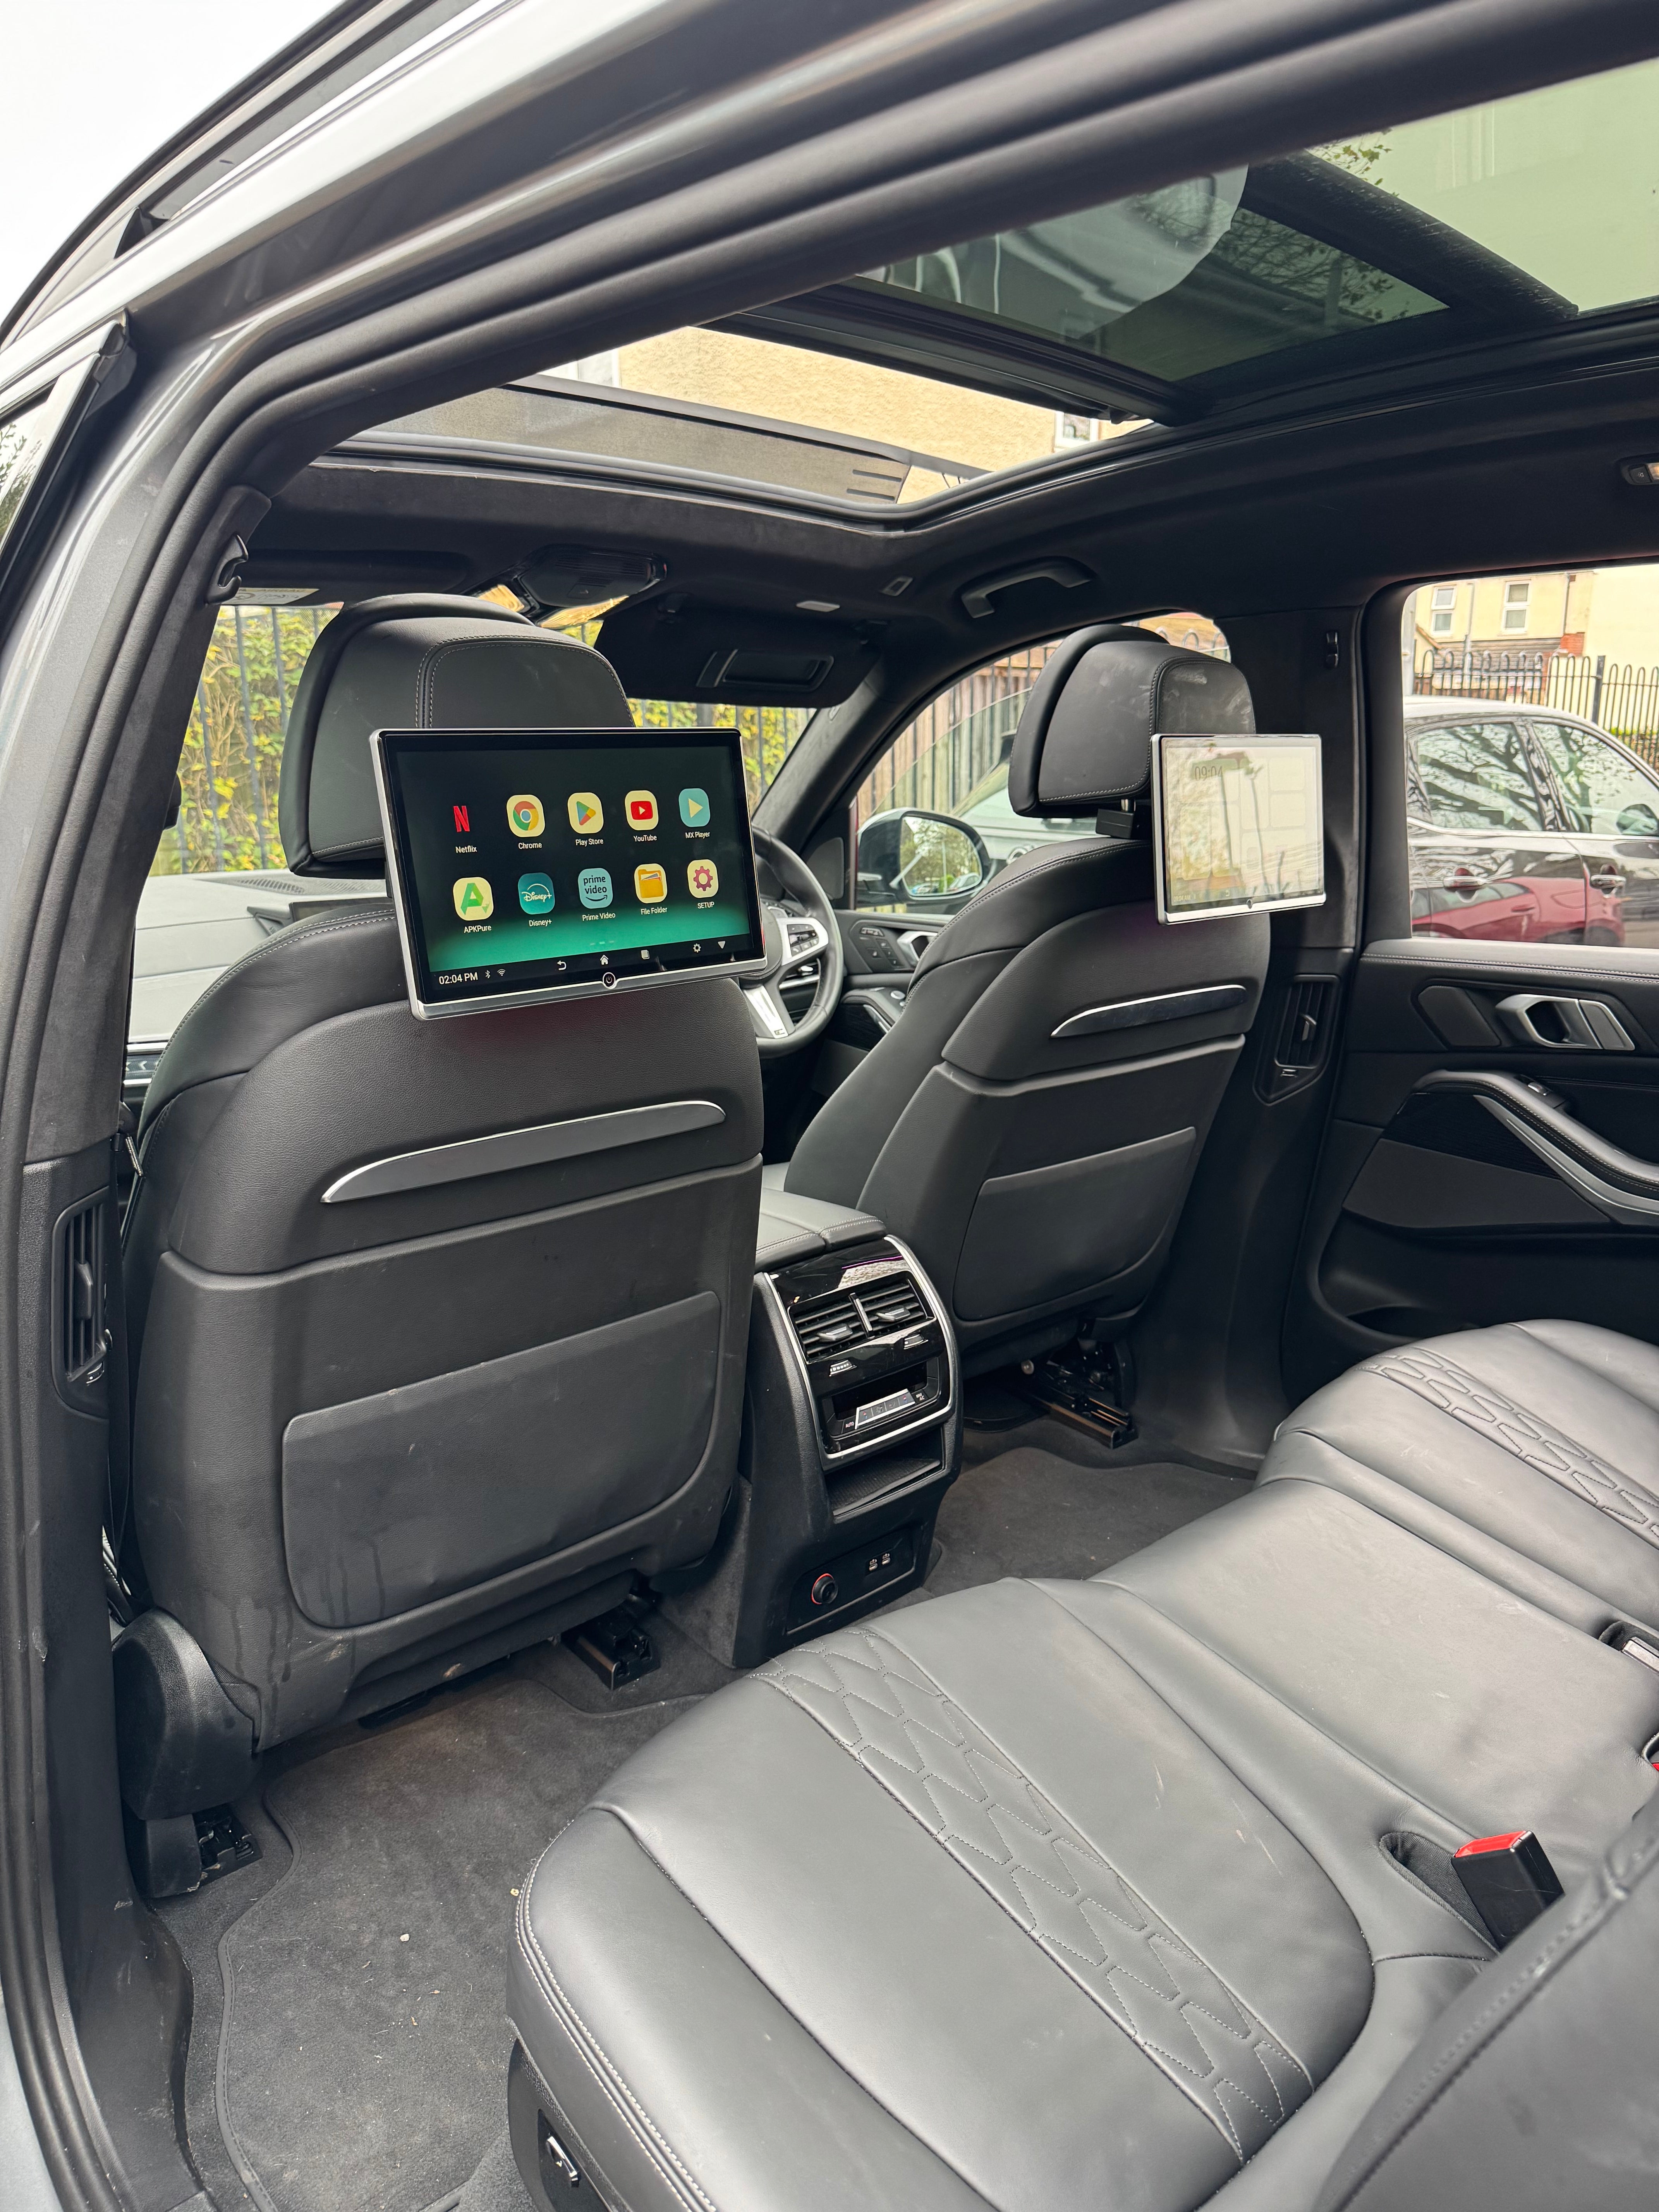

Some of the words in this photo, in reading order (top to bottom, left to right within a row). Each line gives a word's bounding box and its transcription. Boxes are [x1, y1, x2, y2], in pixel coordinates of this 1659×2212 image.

[583, 875, 606, 886] prime
[585, 885, 607, 894] video
[464, 925, 492, 934] APKPure
[439, 974, 463, 984] 02:04
[464, 972, 478, 982] PM
